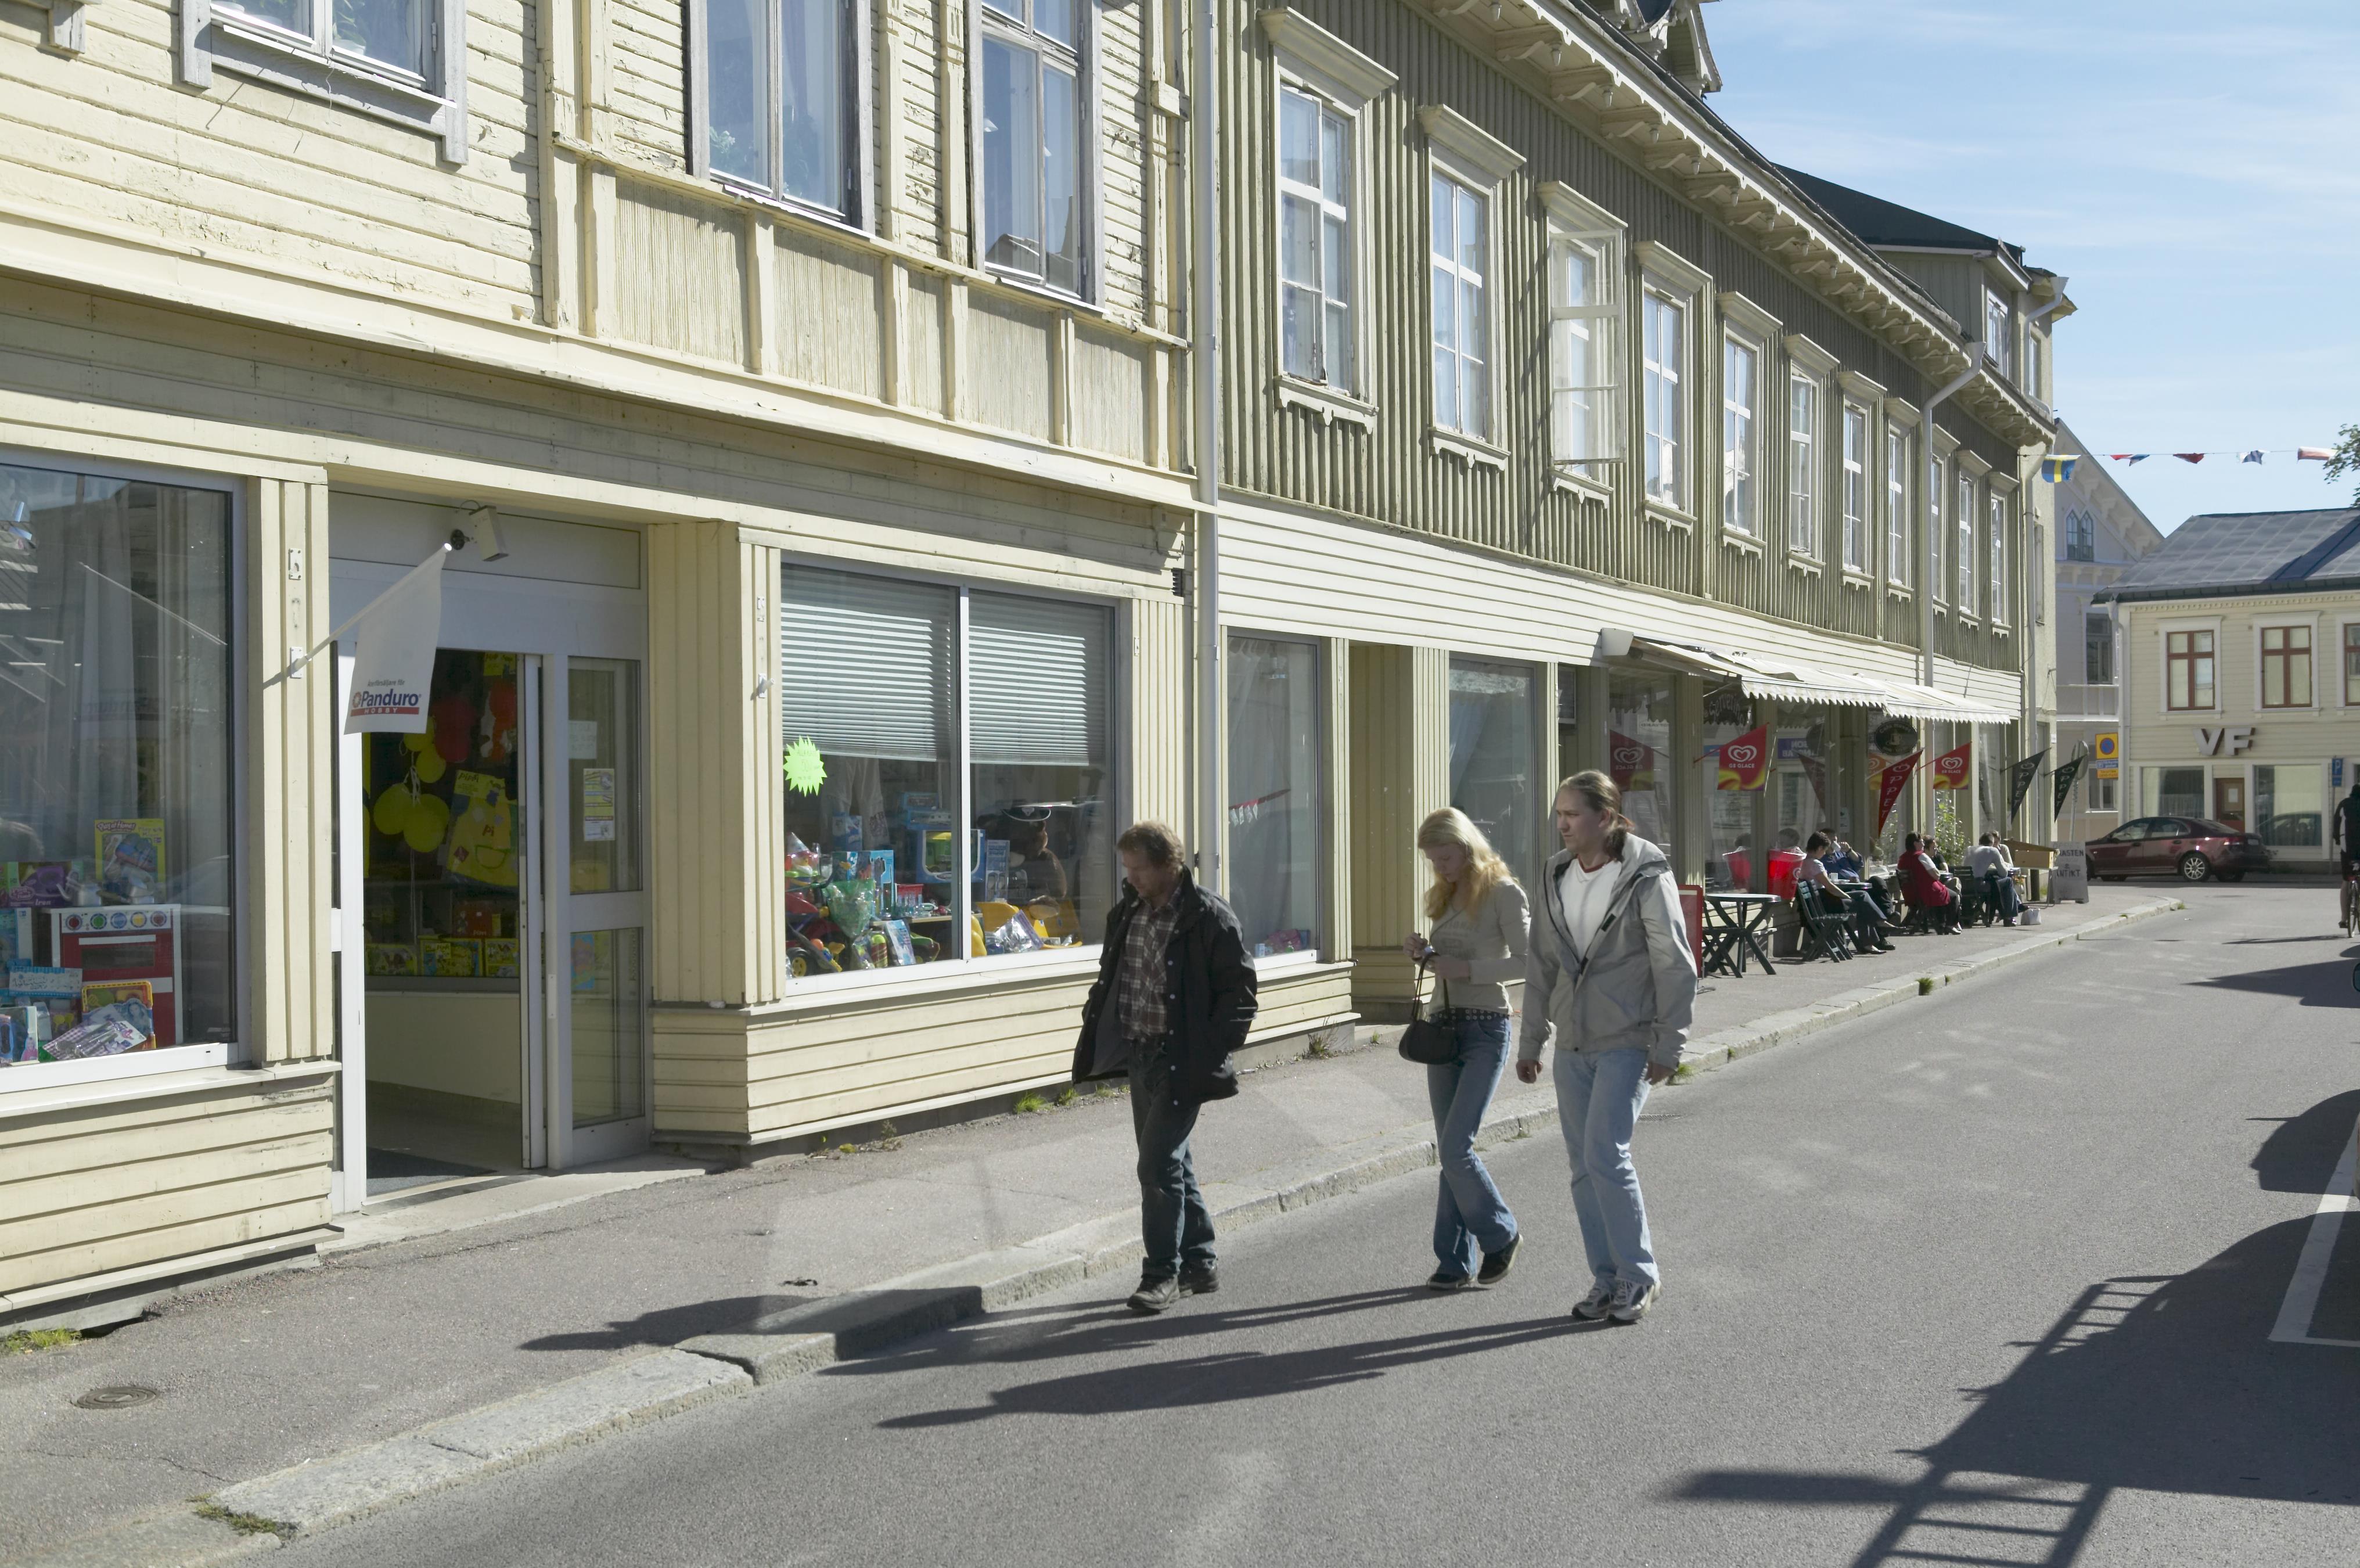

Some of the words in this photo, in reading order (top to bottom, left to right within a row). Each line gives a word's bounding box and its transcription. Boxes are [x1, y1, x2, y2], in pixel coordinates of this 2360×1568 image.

[361, 688, 419, 707] Panduro
[2193, 727, 2256, 756] VF
[2334, 760, 2341, 774] P
